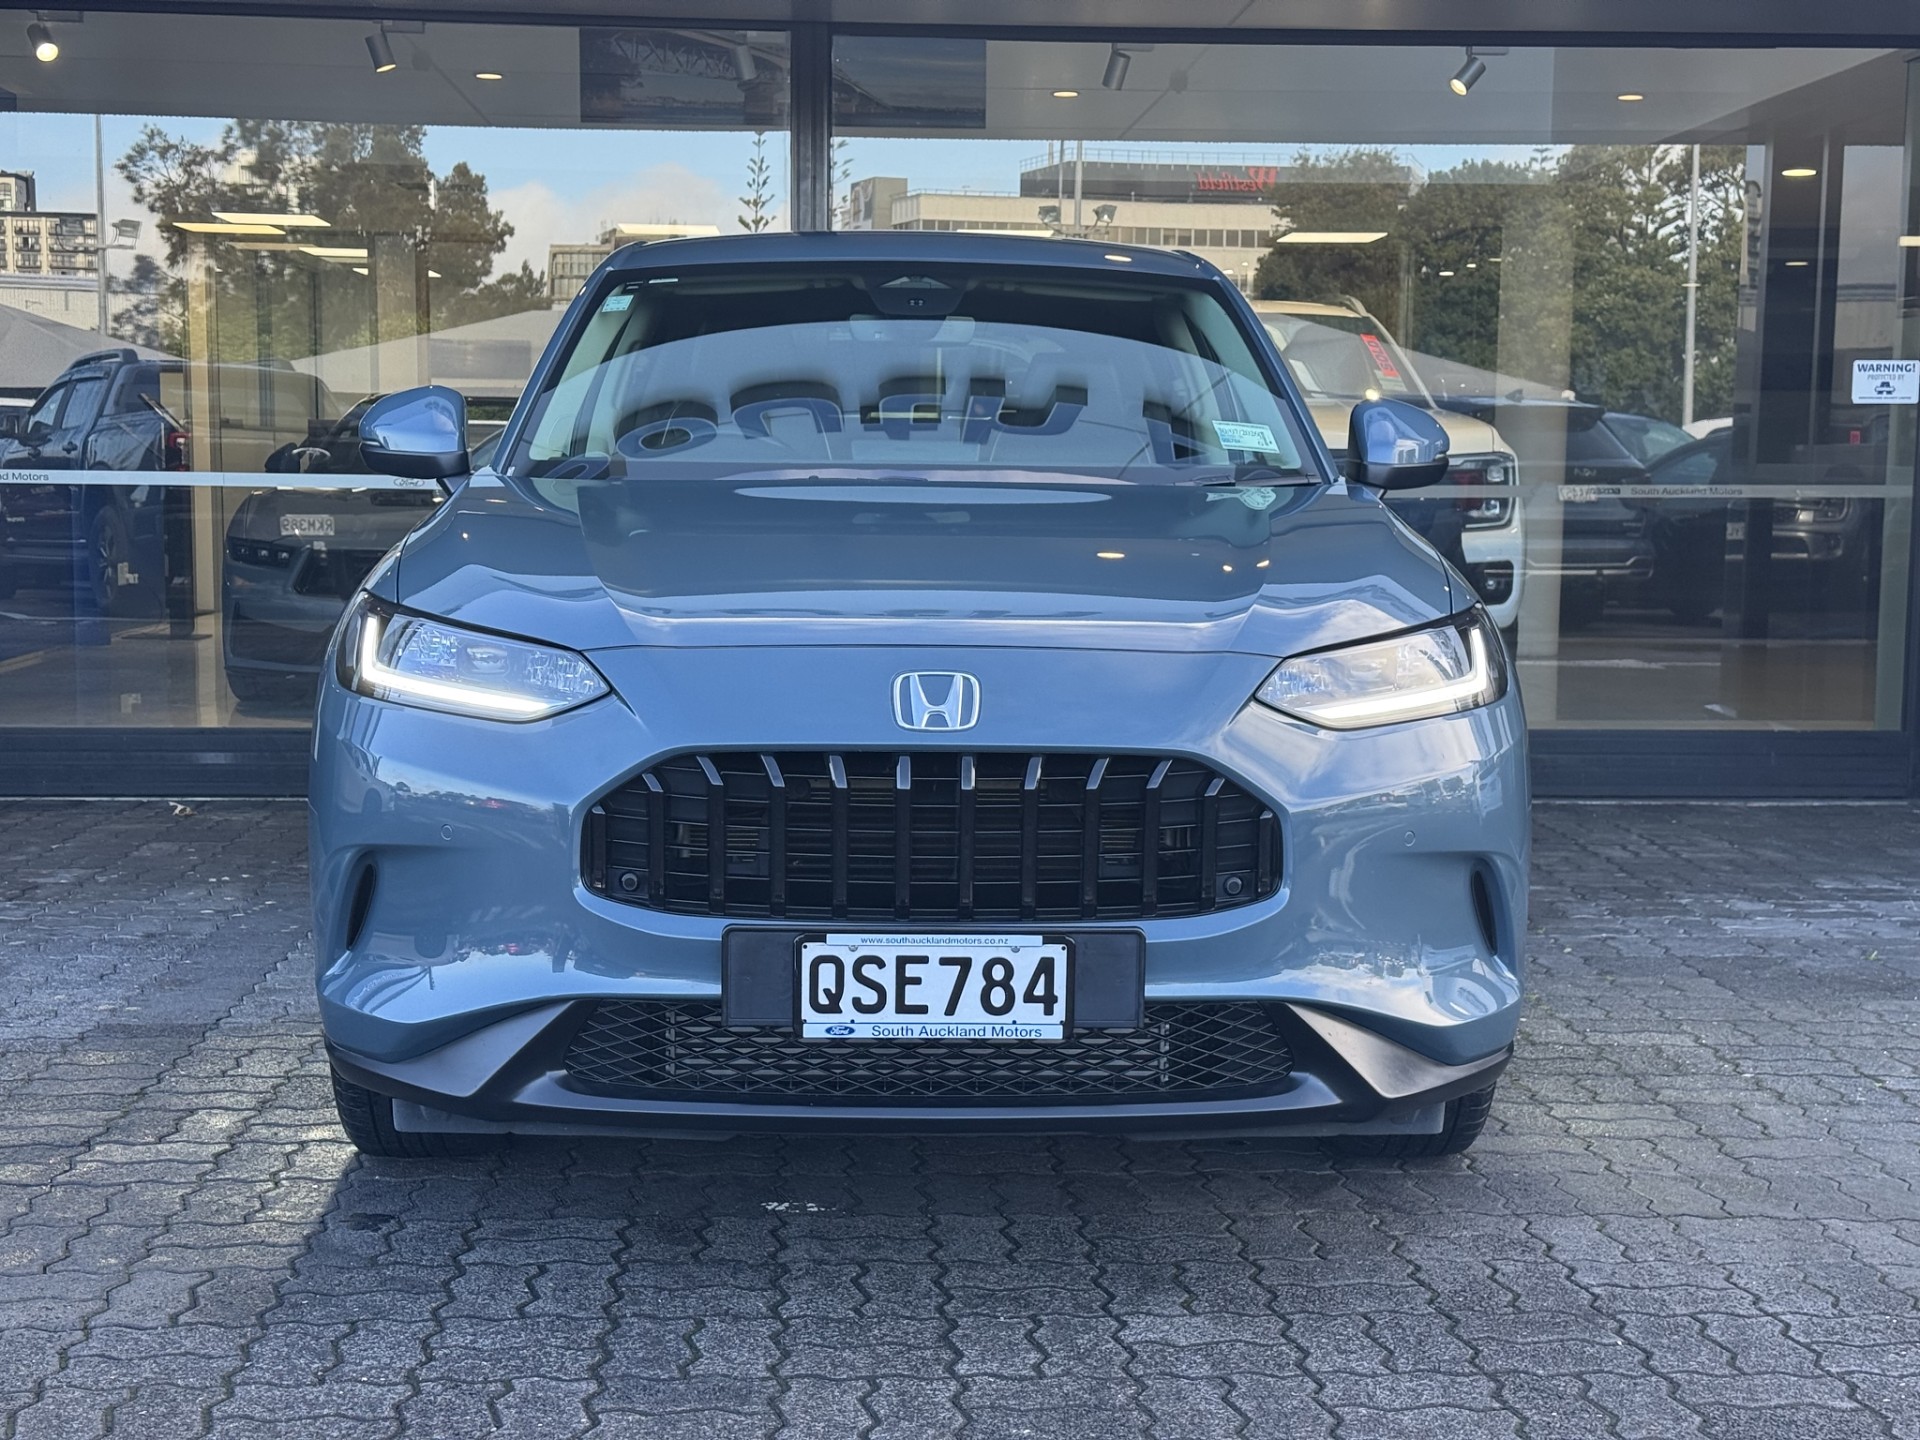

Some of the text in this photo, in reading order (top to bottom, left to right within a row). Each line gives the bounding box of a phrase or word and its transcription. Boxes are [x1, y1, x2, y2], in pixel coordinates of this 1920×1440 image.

[1857, 363, 1916, 373] WARNING!
[12, 472, 50, 481] Motors
[1631, 486, 1659, 496] South
[1661, 486, 1707, 496] Auckland
[1710, 486, 1743, 496] Motors
[860, 935, 1009, 945] www.southaucklandmotors.co.nz
[809, 954, 1058, 1016] QSE784
[871, 1025, 914, 1037] South
[918, 1025, 988, 1038] Auckland
[991, 1026, 1042, 1038] Motors
